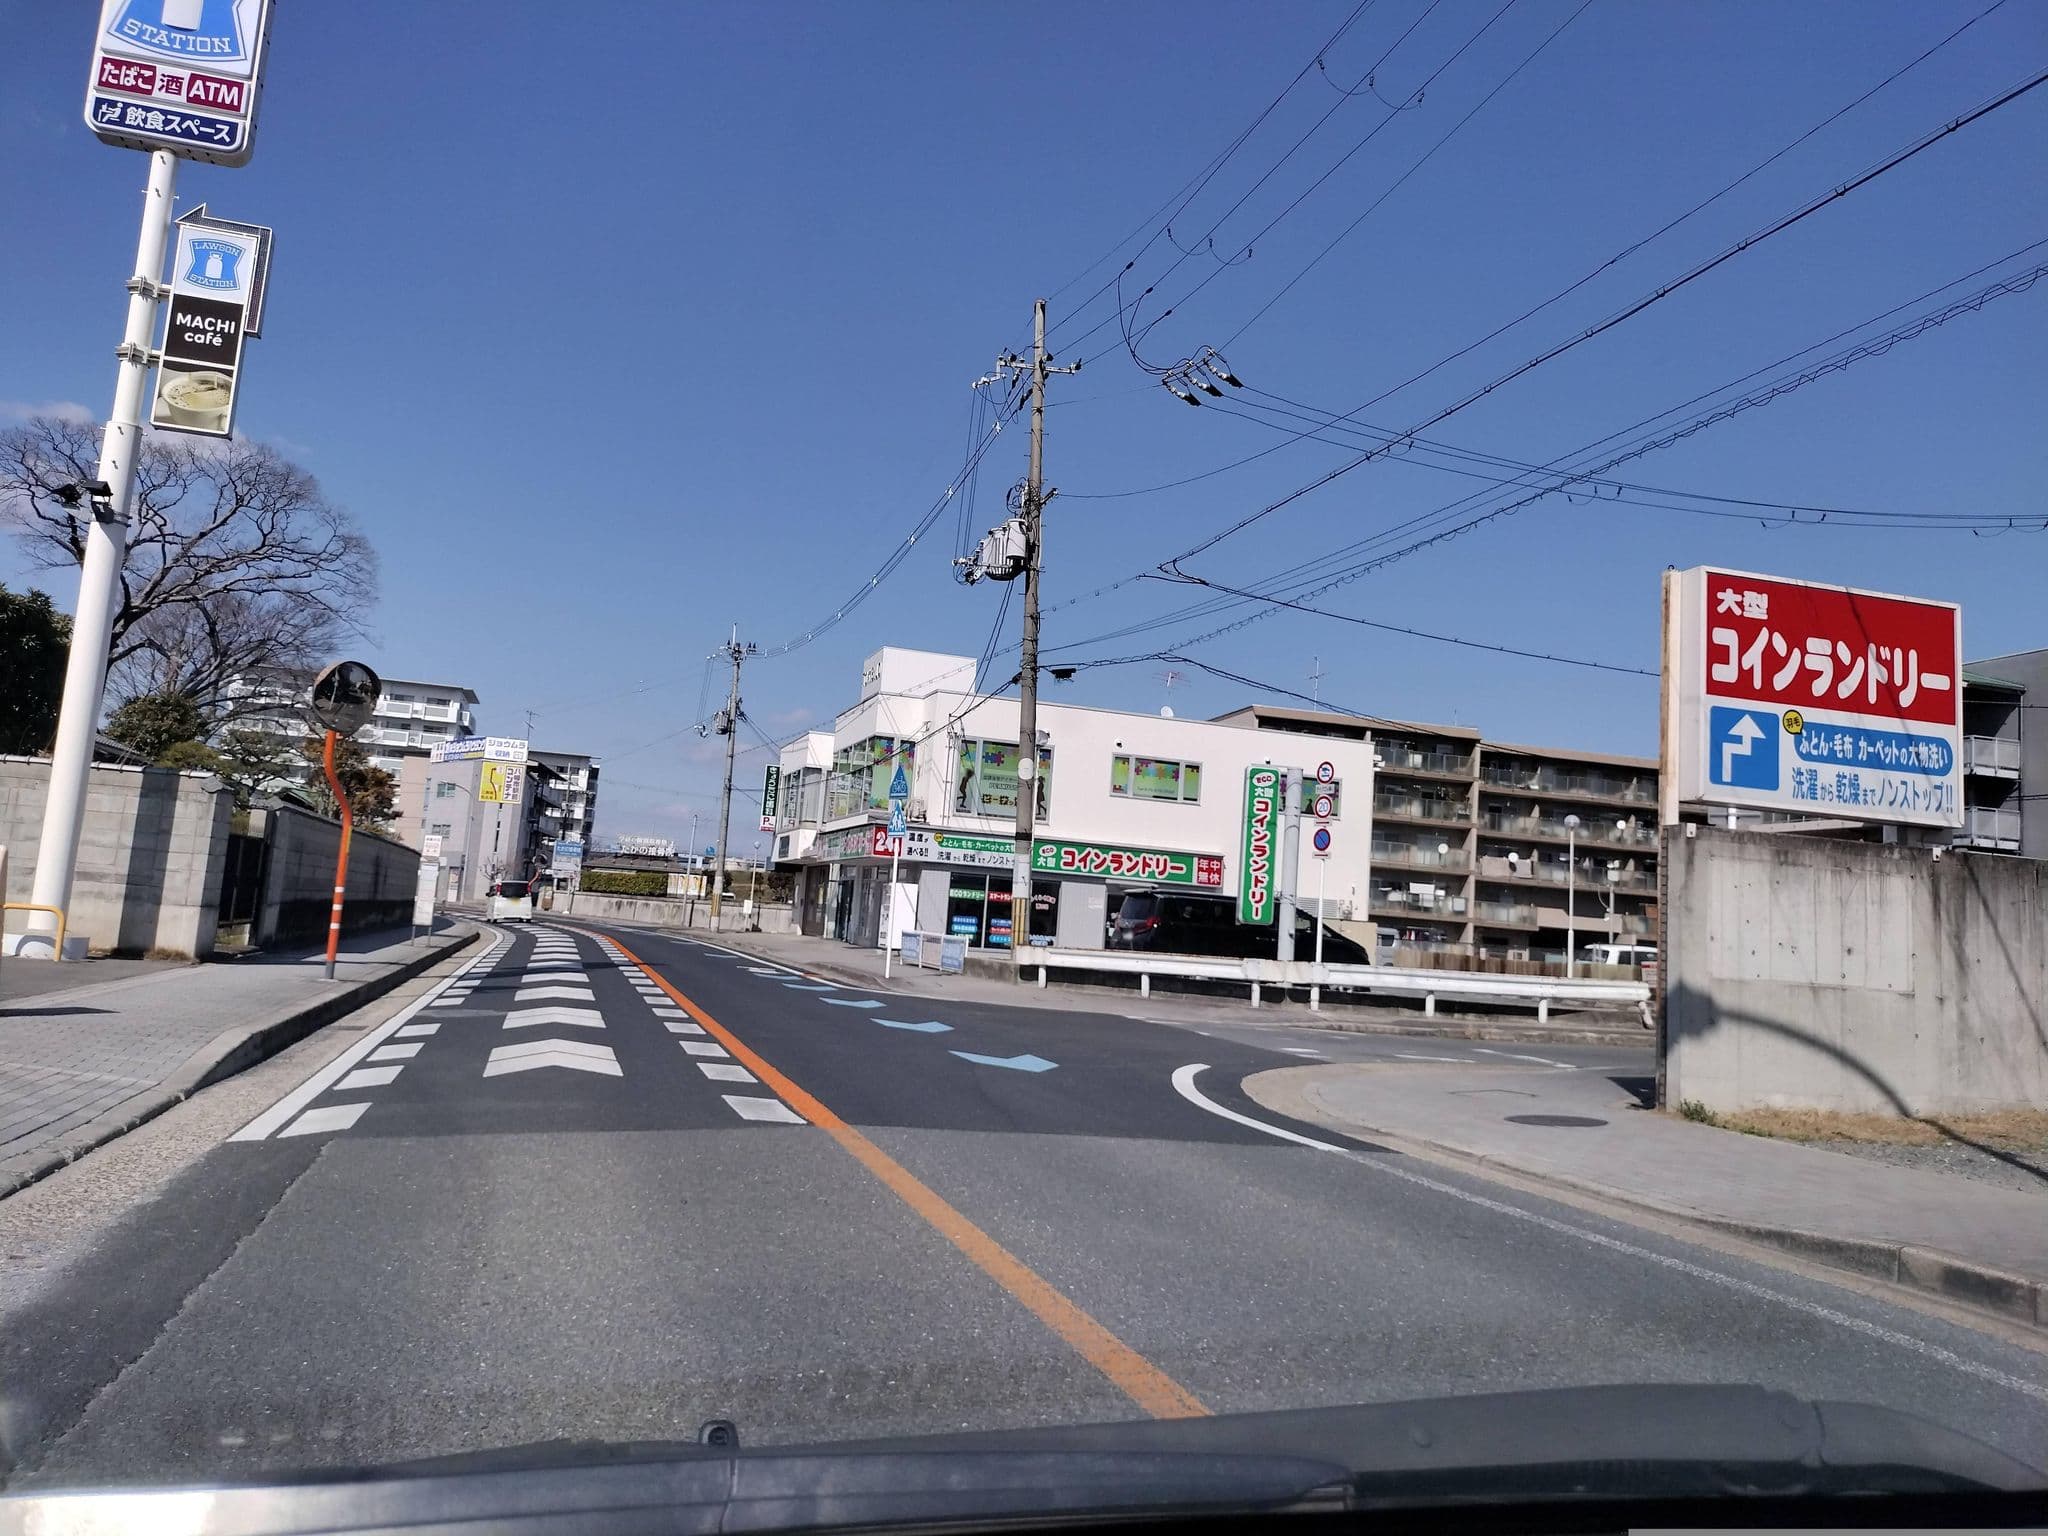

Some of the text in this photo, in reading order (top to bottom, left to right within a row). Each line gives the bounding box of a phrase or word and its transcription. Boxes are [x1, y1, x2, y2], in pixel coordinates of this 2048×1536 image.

[122, 18, 232, 53] STATION
[101, 62, 239, 106] たばこ 酒 ATM
[125, 106, 231, 143] 飲食スペース
[189, 273, 234, 289] STATION
[176, 312, 236, 334] MACHI
[184, 331, 223, 347] café
[1716, 588, 1769, 620] 大型
[1711, 626, 1951, 708] コインランドリー
[1785, 716, 1801, 728] 羽毛
[488, 739, 526, 749] ジョウムラ
[1858, 739, 1949, 771] カーペットの大物洗い
[1256, 775, 1272, 784] ECO
[1254, 787, 1274, 798] 大型
[1319, 801, 1329, 812] 20
[1037, 857, 1056, 867] 大型
[1061, 849, 1186, 877] コインランドリー
[1199, 859, 1221, 870] 年中
[1251, 799, 1270, 918] コインランドリー
[1198, 872, 1220, 884] 無休
